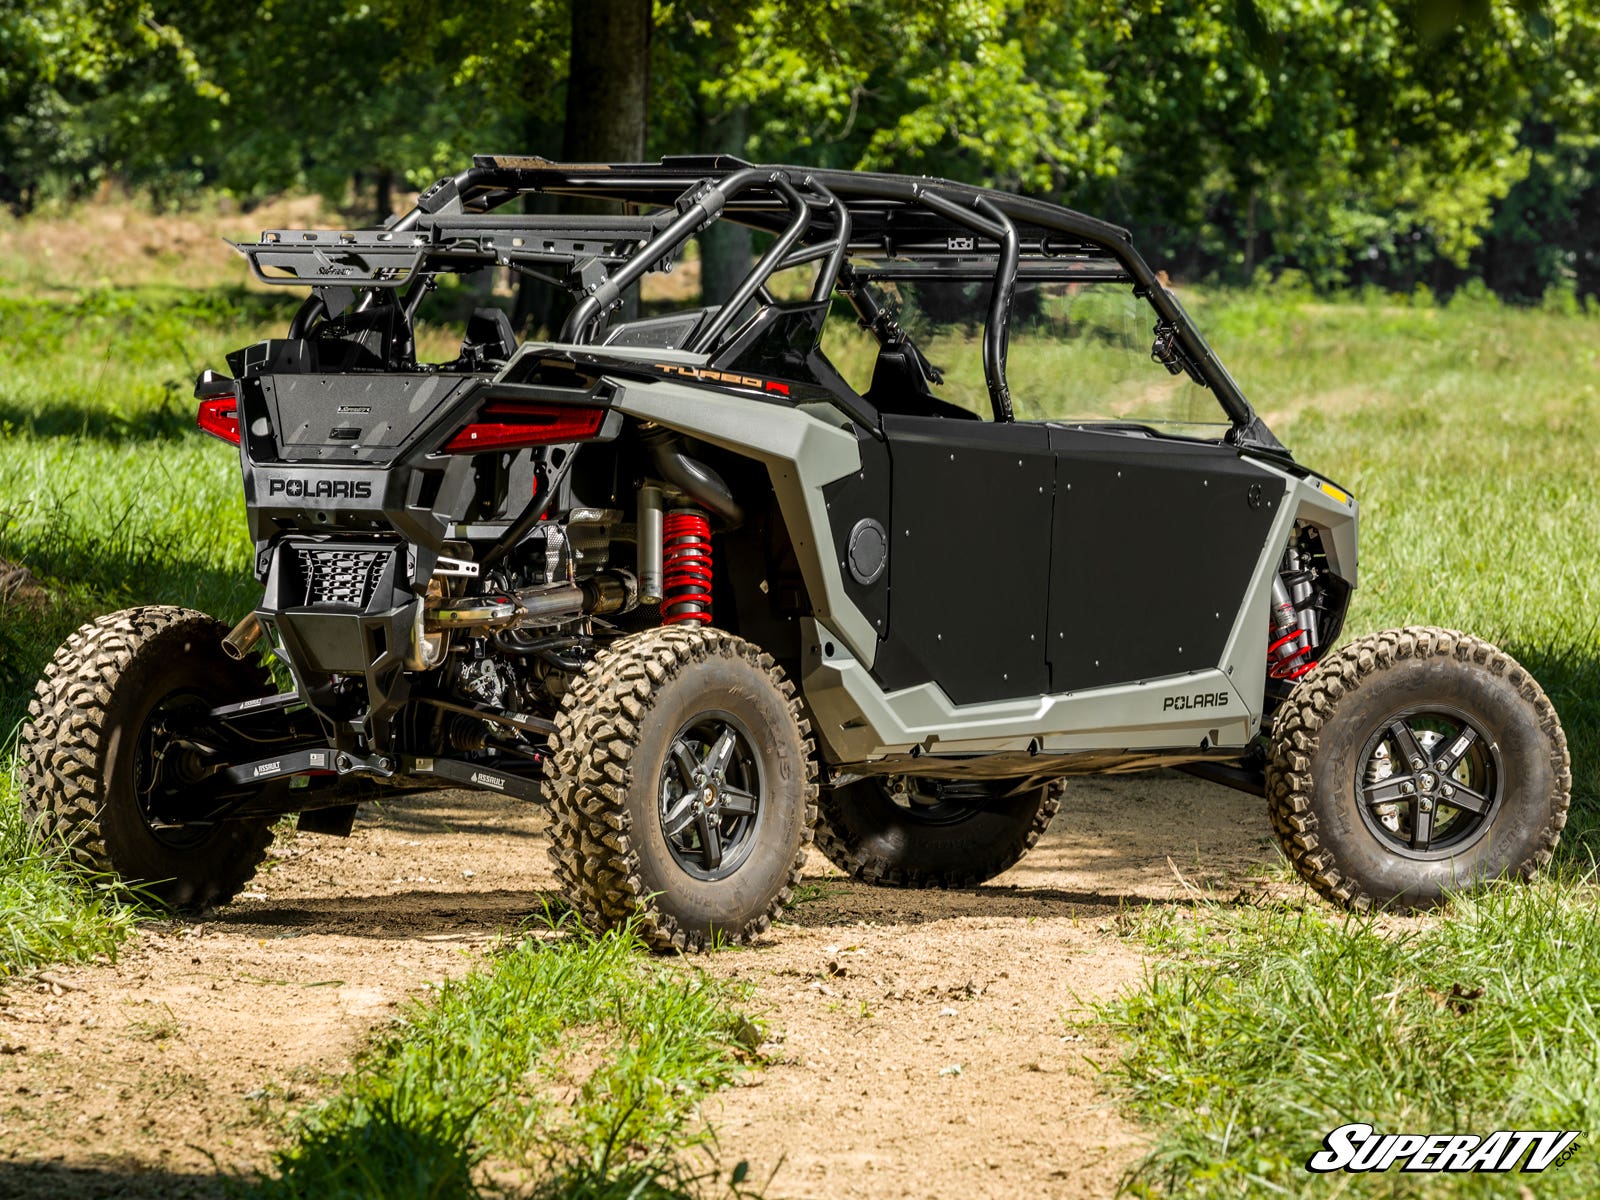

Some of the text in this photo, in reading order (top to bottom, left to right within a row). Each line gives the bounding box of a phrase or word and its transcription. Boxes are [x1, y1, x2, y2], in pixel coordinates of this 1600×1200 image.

[655, 363, 762, 388] TURBO
[269, 479, 372, 498] POLARIS
[1163, 692, 1229, 711] POLARIS
[258, 762, 280, 774] ASSAULT
[478, 773, 505, 788] ASSAULT
